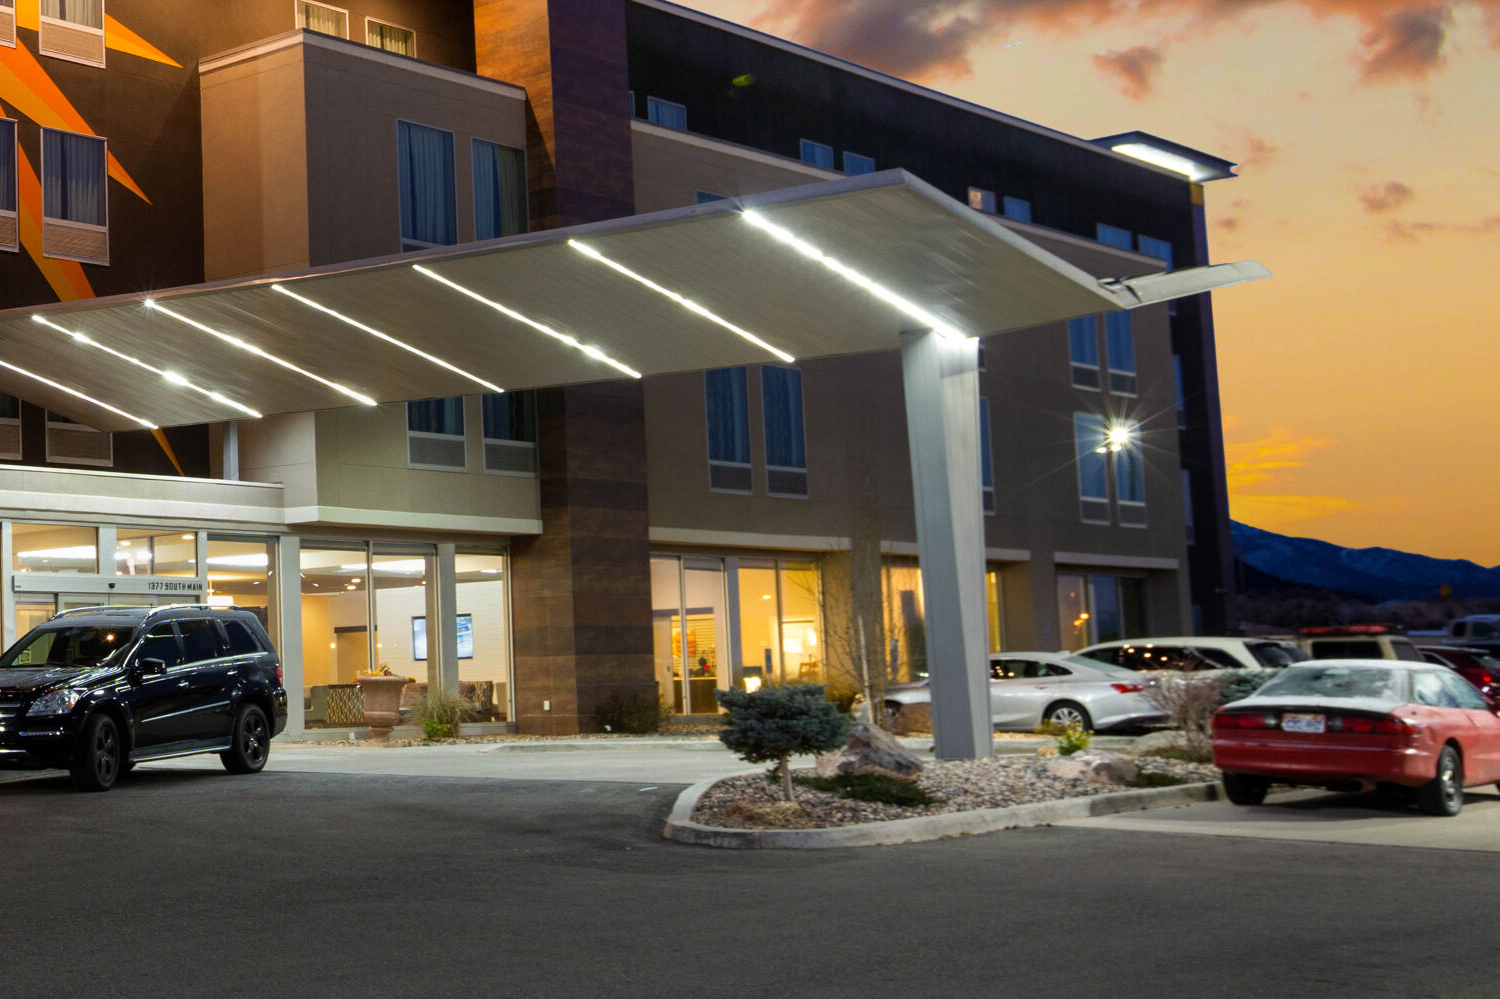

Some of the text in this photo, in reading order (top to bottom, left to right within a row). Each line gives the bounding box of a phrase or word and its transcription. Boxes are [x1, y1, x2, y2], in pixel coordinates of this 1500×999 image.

[148, 581, 203, 591] 1377 SOUTH MAIN
